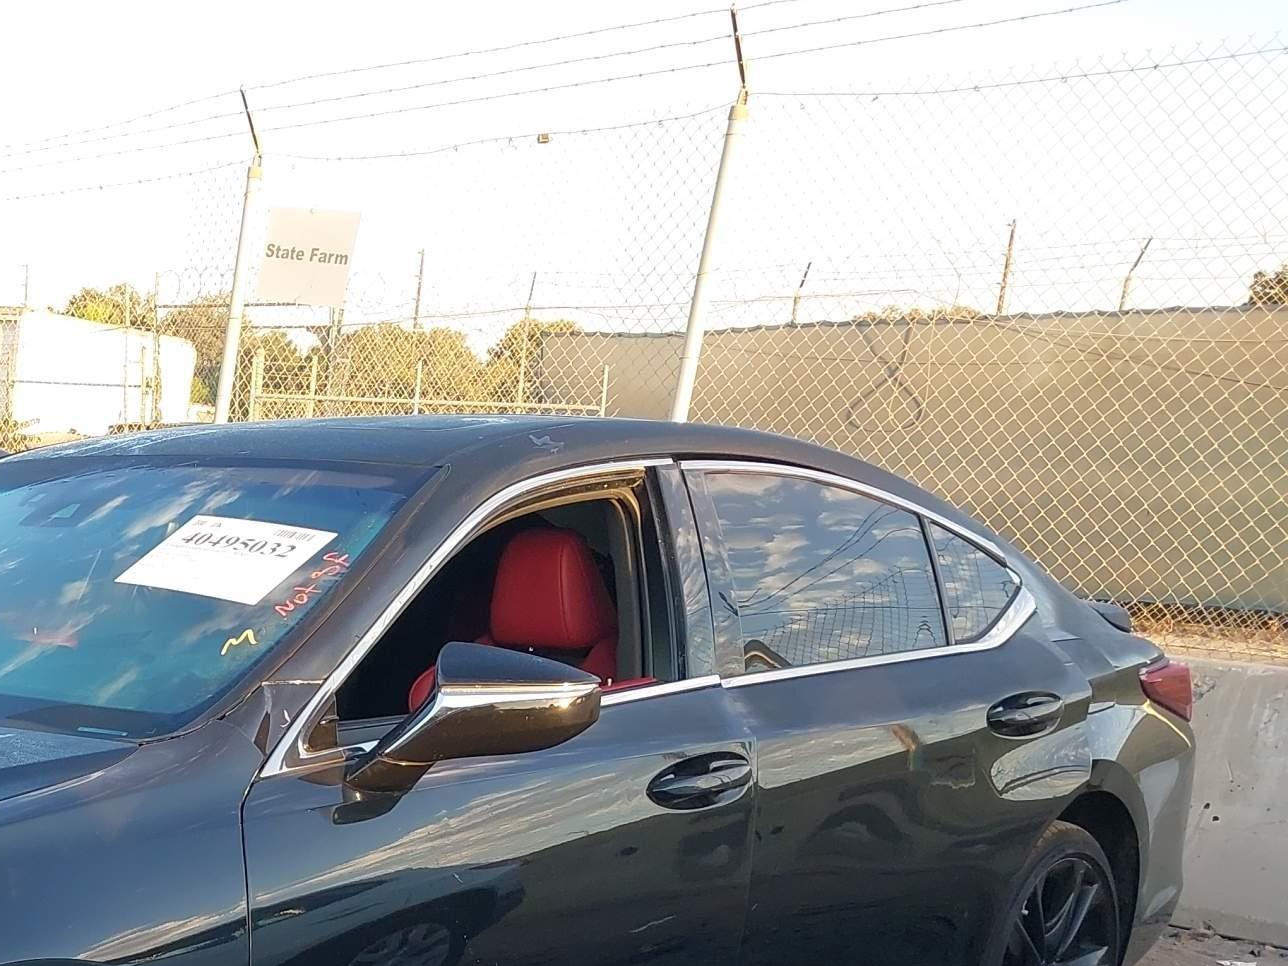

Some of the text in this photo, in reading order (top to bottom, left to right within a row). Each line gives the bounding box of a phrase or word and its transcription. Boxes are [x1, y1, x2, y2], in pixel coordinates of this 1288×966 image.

[265, 243, 349, 265] State Farm
[182, 531, 297, 558] 40495032
